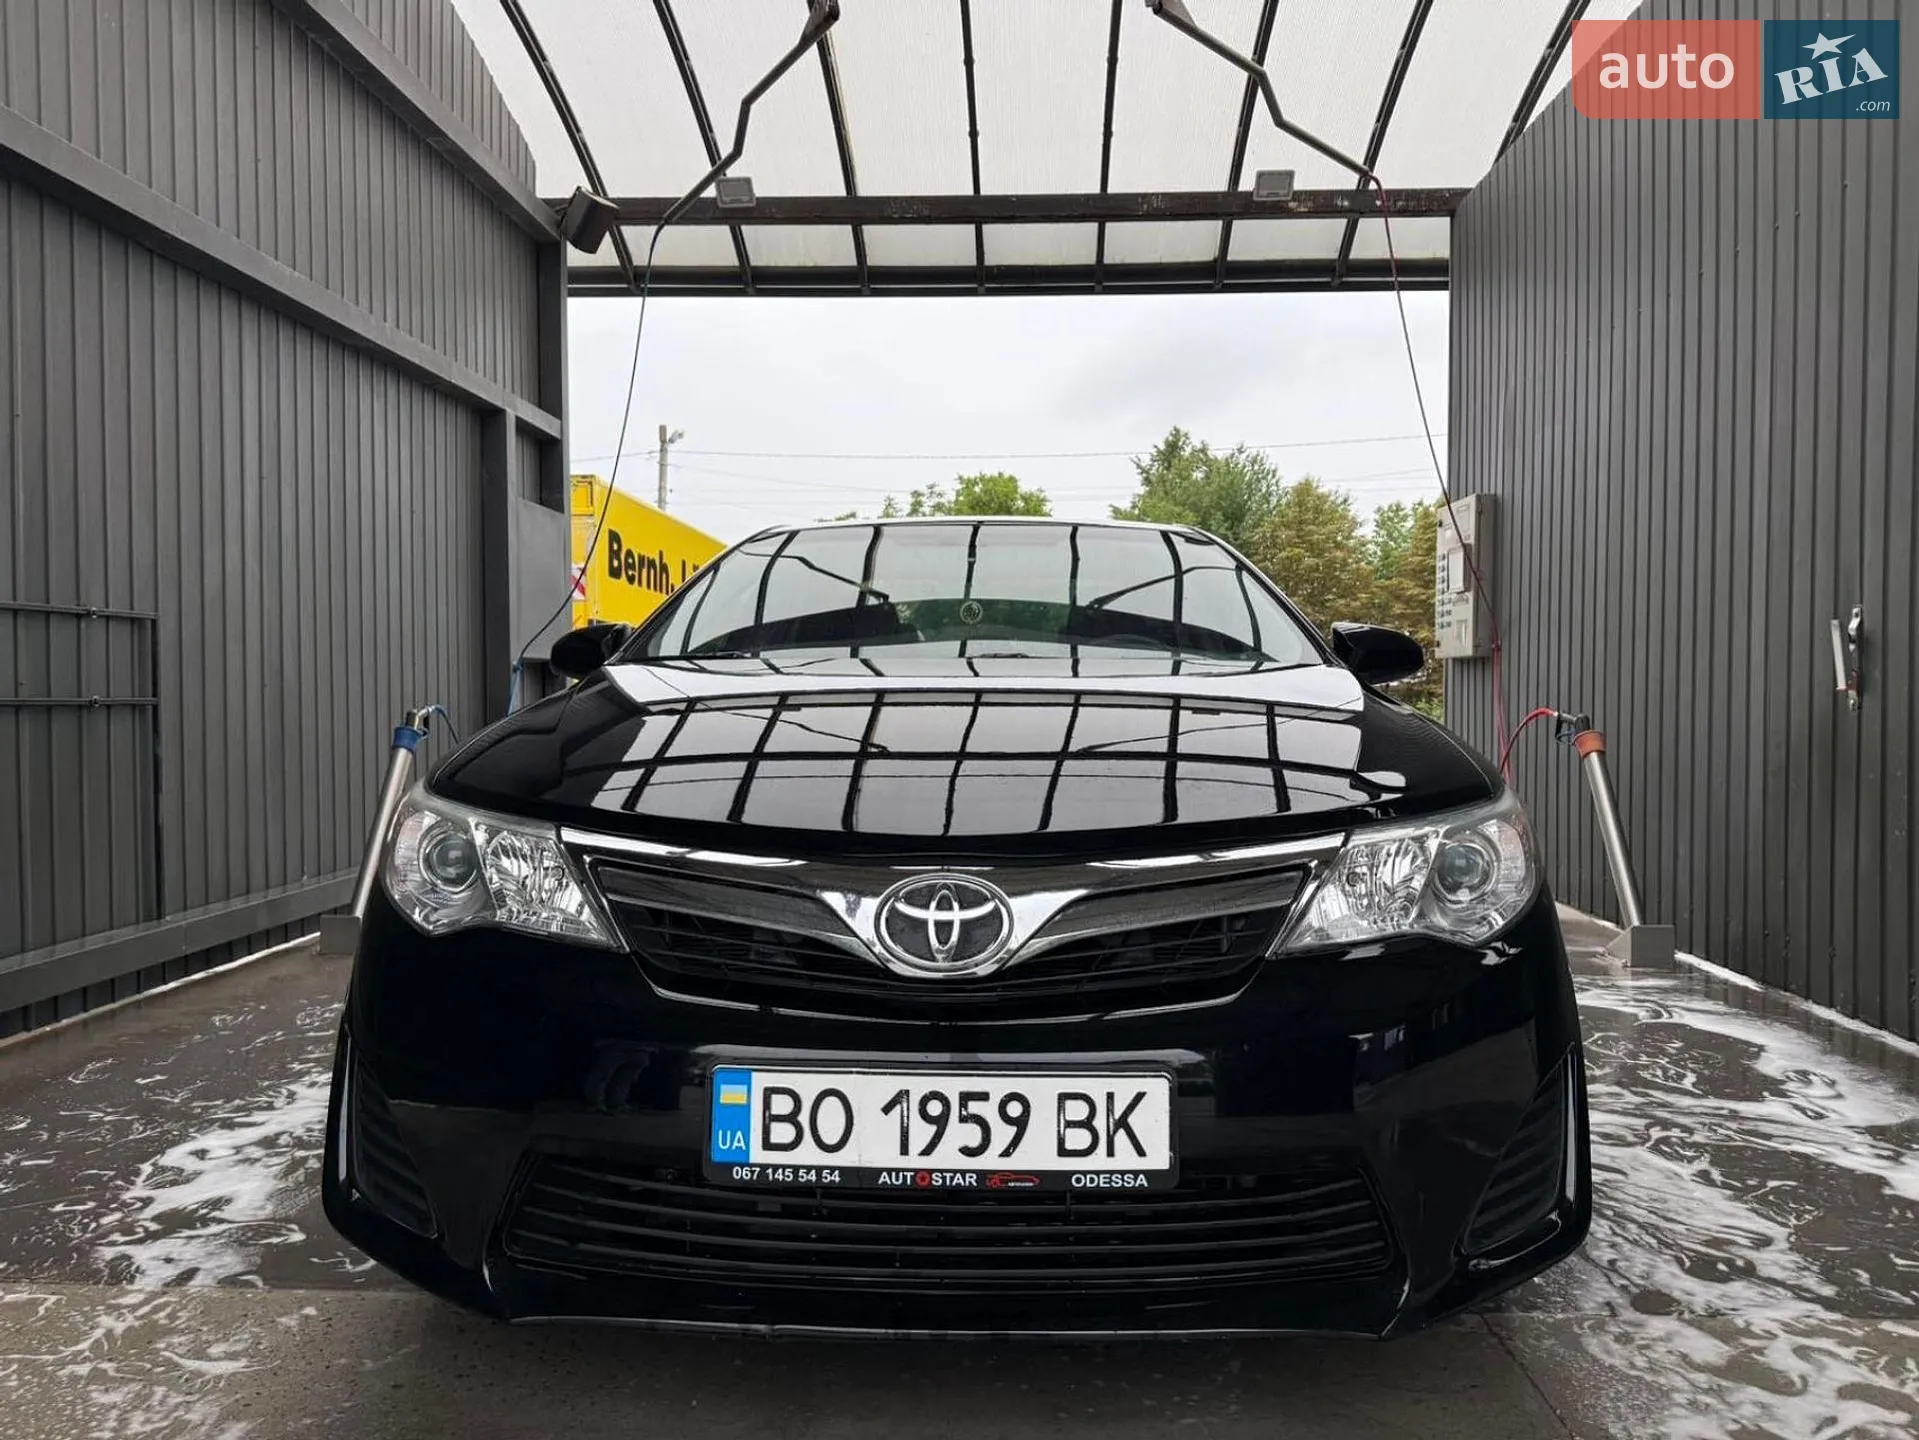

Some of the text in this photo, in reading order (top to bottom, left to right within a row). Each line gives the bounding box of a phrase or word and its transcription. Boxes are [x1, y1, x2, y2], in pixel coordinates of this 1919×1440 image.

[762, 1086, 1148, 1158] BO 1959 BK
[717, 1130, 747, 1151] UA
[732, 1166, 841, 1184] 067 145 54 54
[1071, 1174, 1149, 1188] ODESSA
